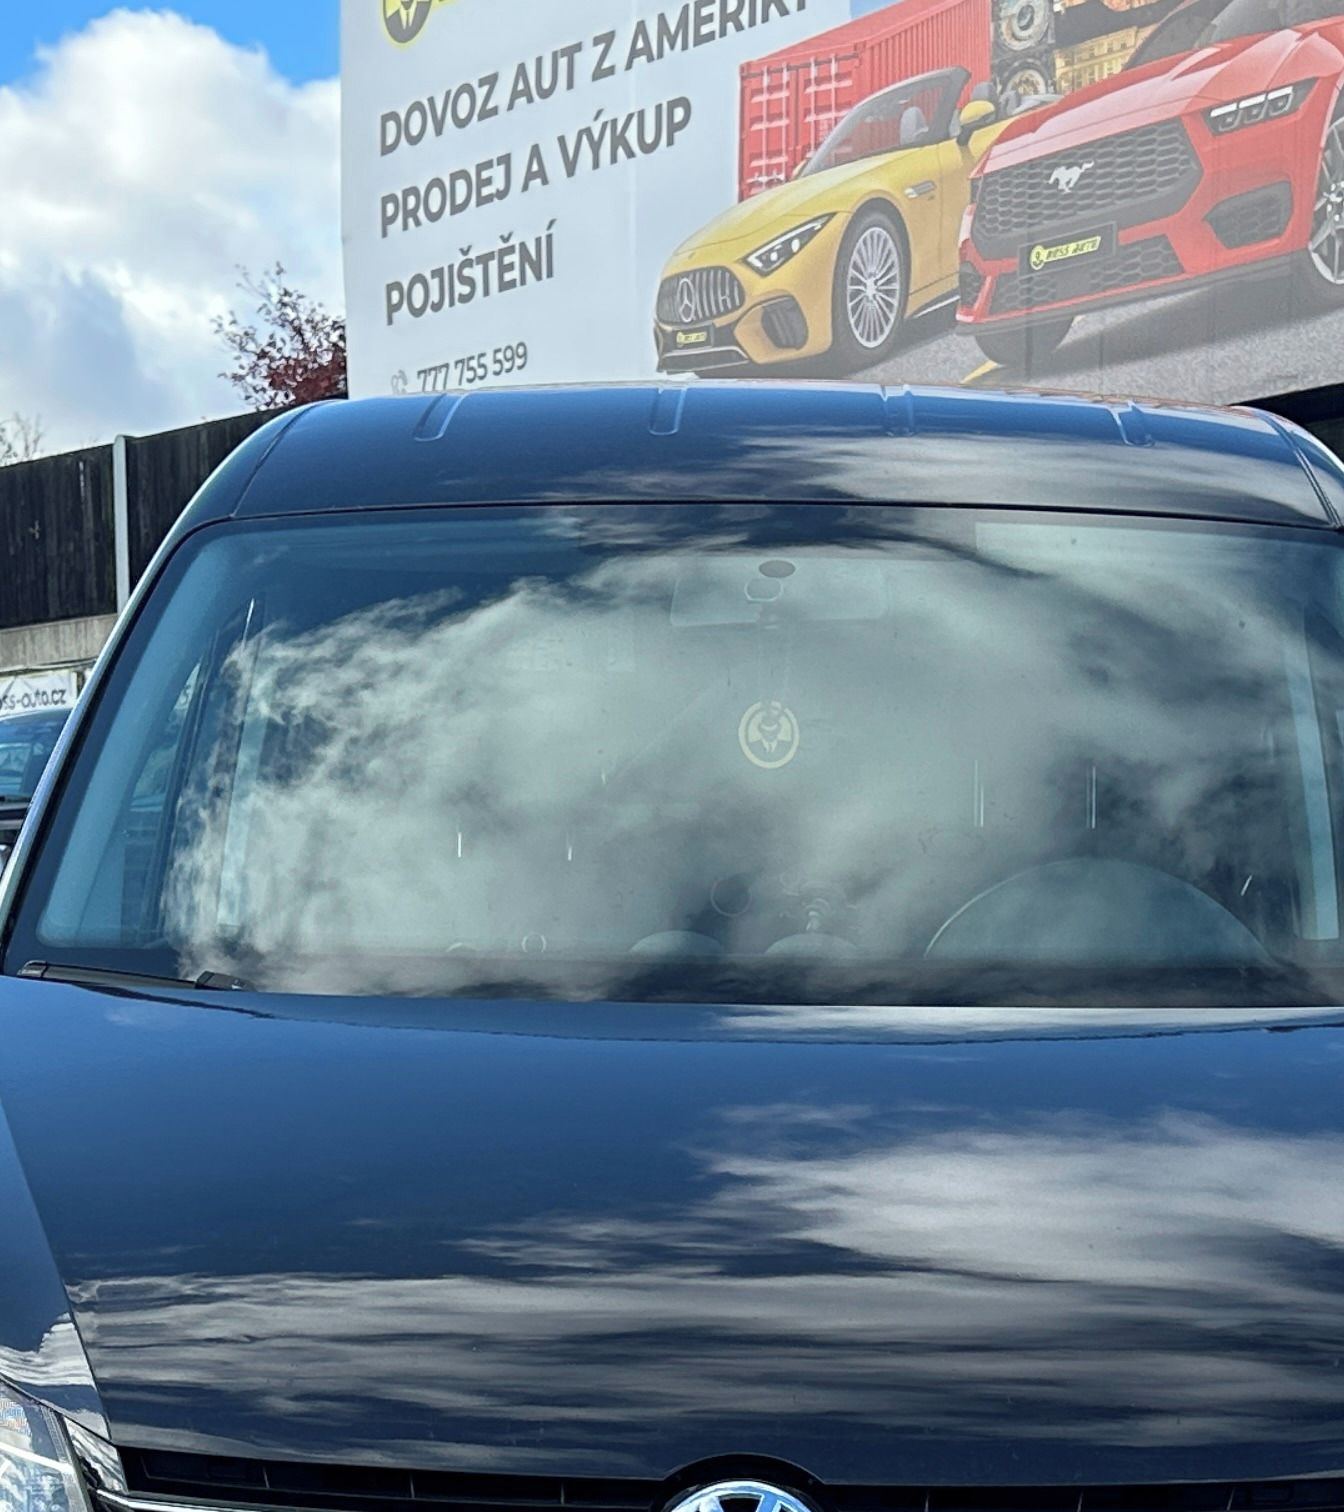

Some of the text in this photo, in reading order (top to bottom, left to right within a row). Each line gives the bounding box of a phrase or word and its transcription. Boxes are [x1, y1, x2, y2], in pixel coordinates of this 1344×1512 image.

[380, 0, 807, 157] DOVOZ AUT Z AMERIK
[381, 96, 692, 238] PRODEJ A VÝKUP
[385, 219, 558, 325] POJIŠTĚNÍ
[416, 341, 528, 392] 777 755 599
